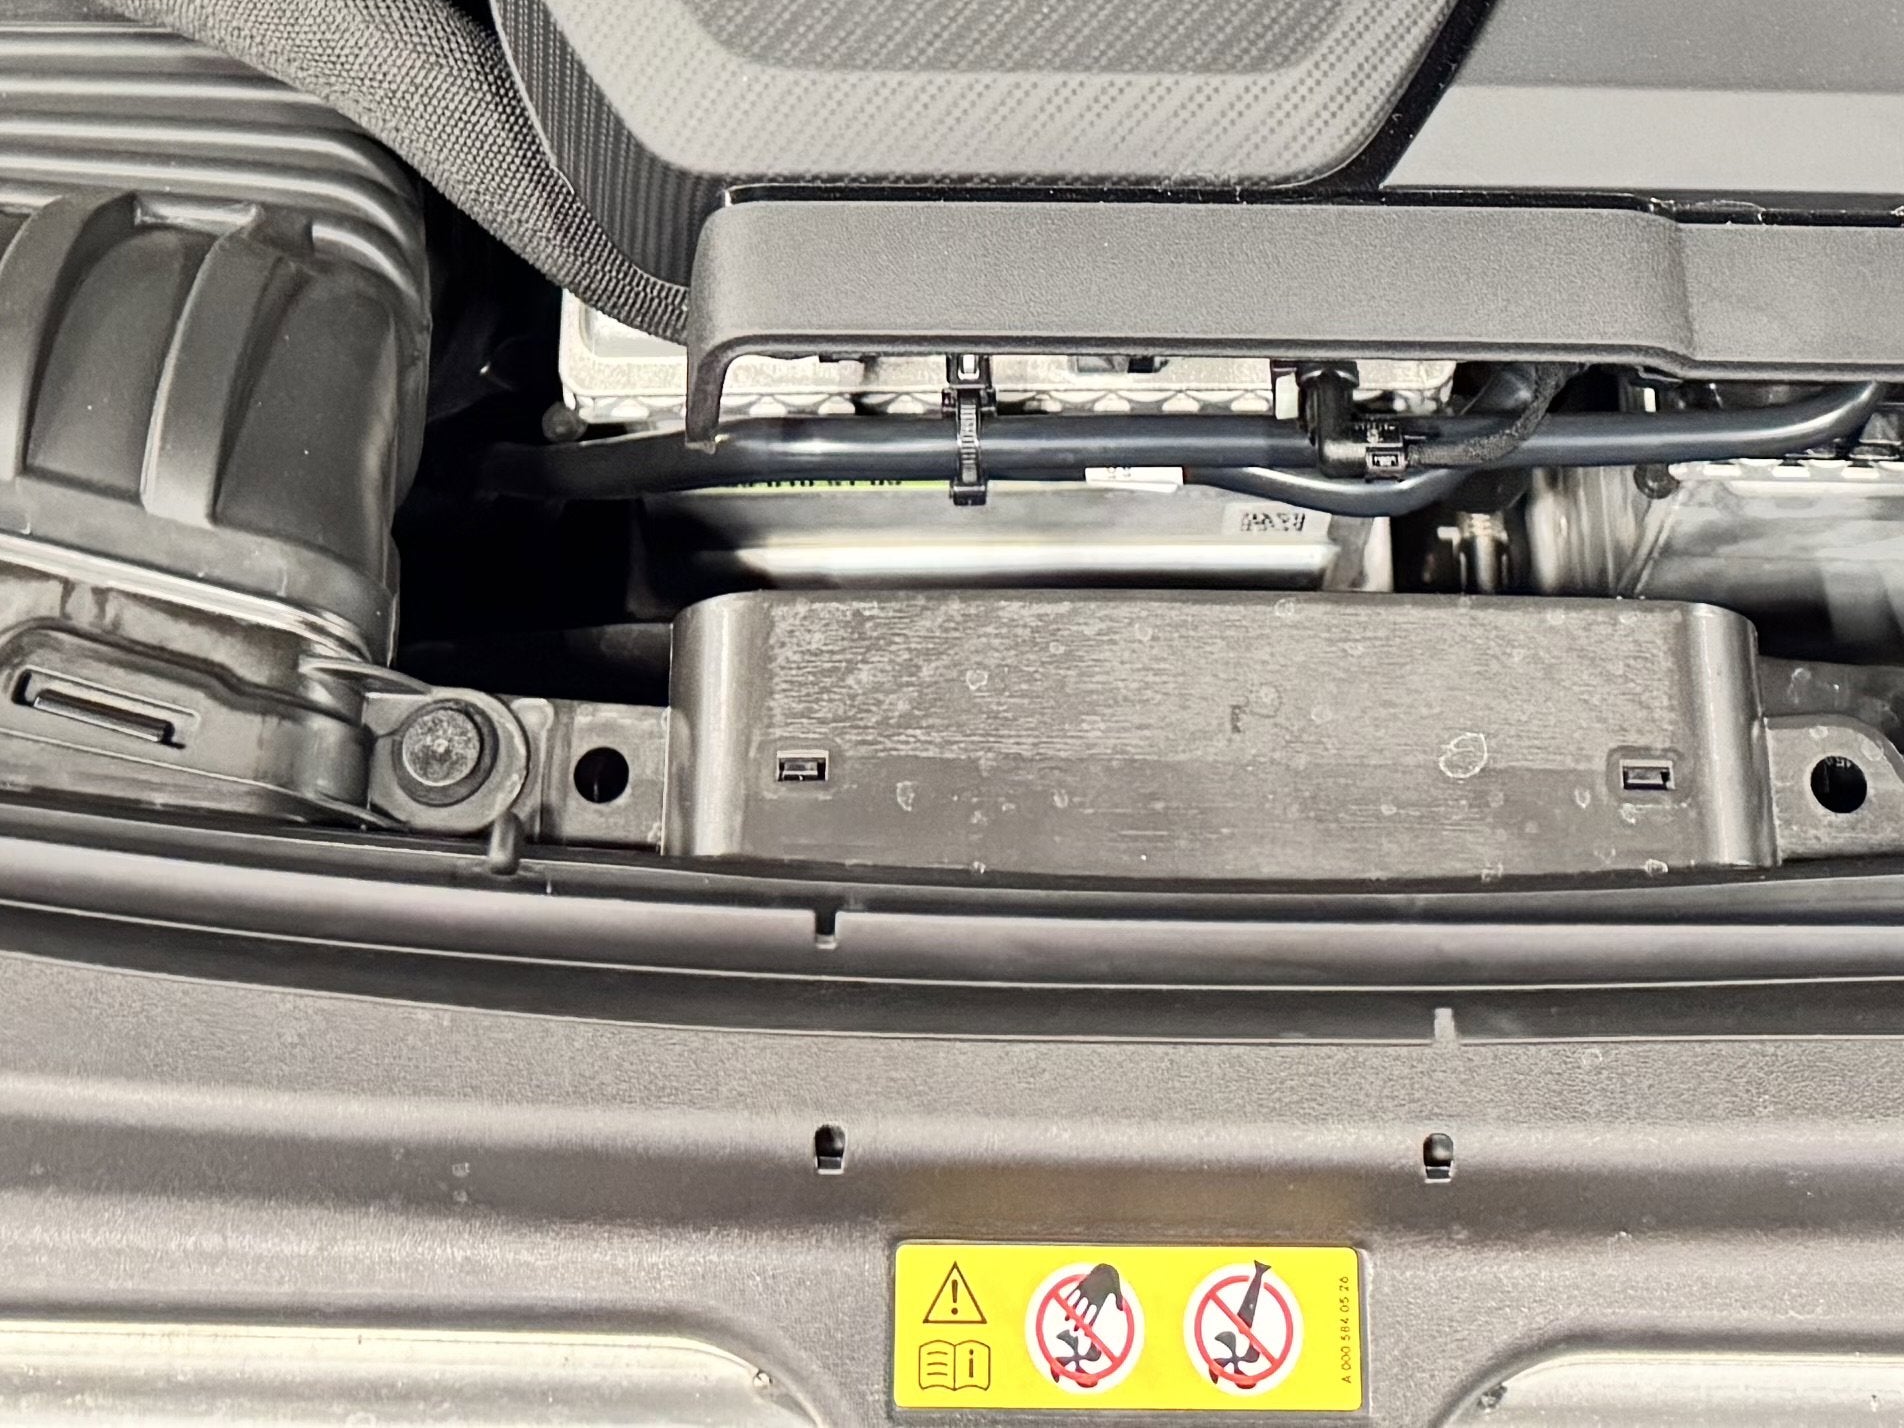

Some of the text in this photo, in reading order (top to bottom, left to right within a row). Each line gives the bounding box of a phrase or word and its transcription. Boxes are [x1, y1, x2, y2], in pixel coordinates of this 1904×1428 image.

[1339, 1296, 1350, 1313] 05
[1340, 1318, 1351, 1341] 584
[1340, 1346, 1352, 1371] 000
[1341, 1375, 1352, 1384] A
